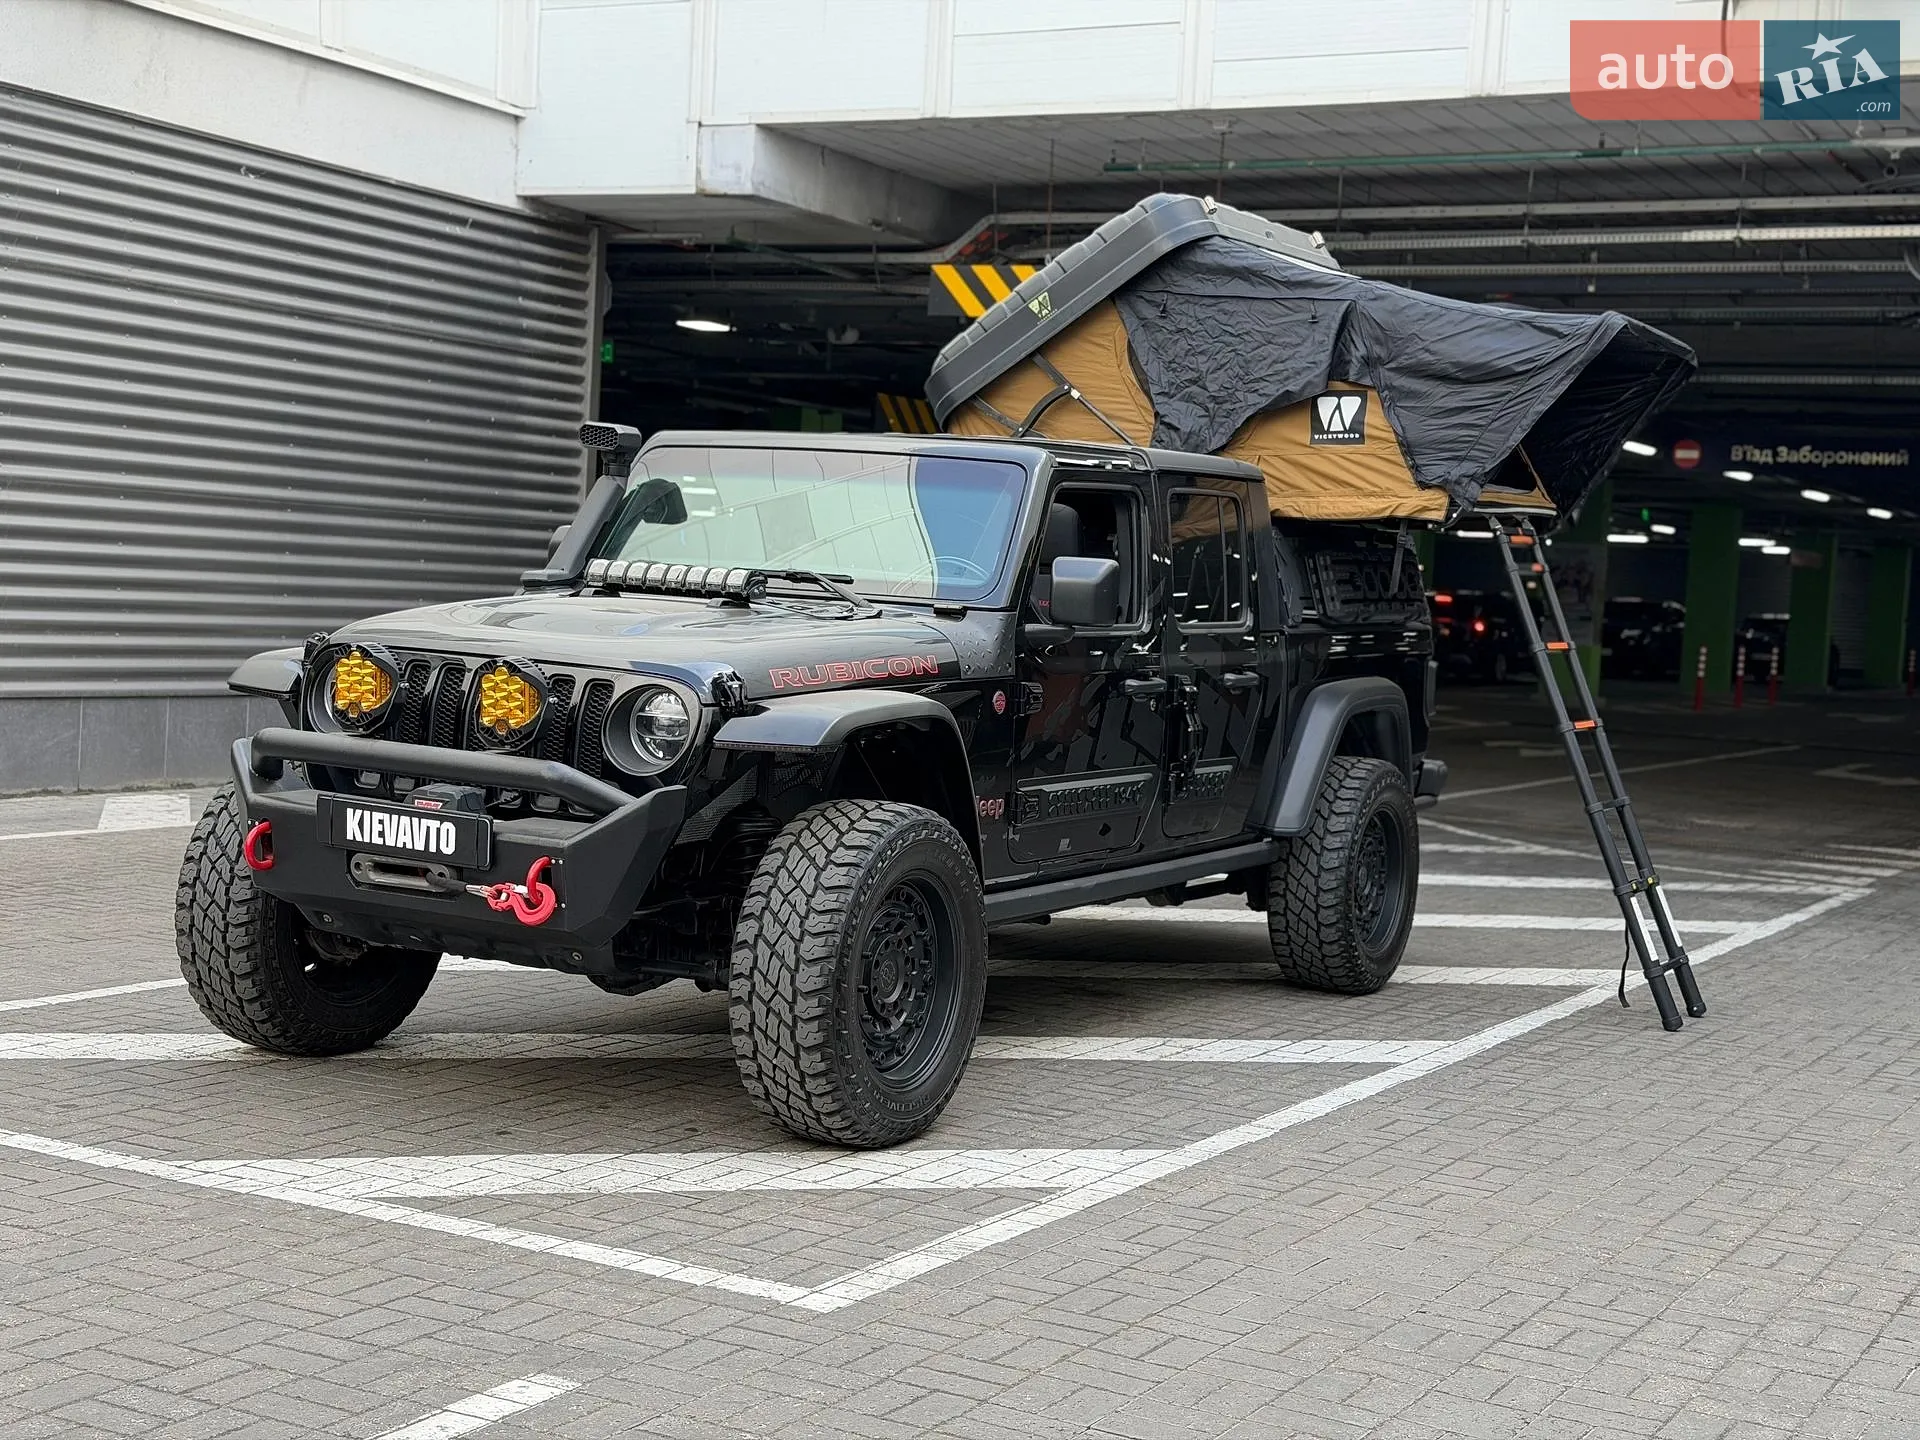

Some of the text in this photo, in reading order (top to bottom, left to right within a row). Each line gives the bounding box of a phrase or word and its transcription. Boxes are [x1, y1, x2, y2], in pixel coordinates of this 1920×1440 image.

[1313, 432, 1360, 440] VICKYWOOD
[1775, 445, 1910, 468] Заборонений
[768, 654, 939, 689] RUBICON
[346, 807, 456, 855] KIEVAVTO
